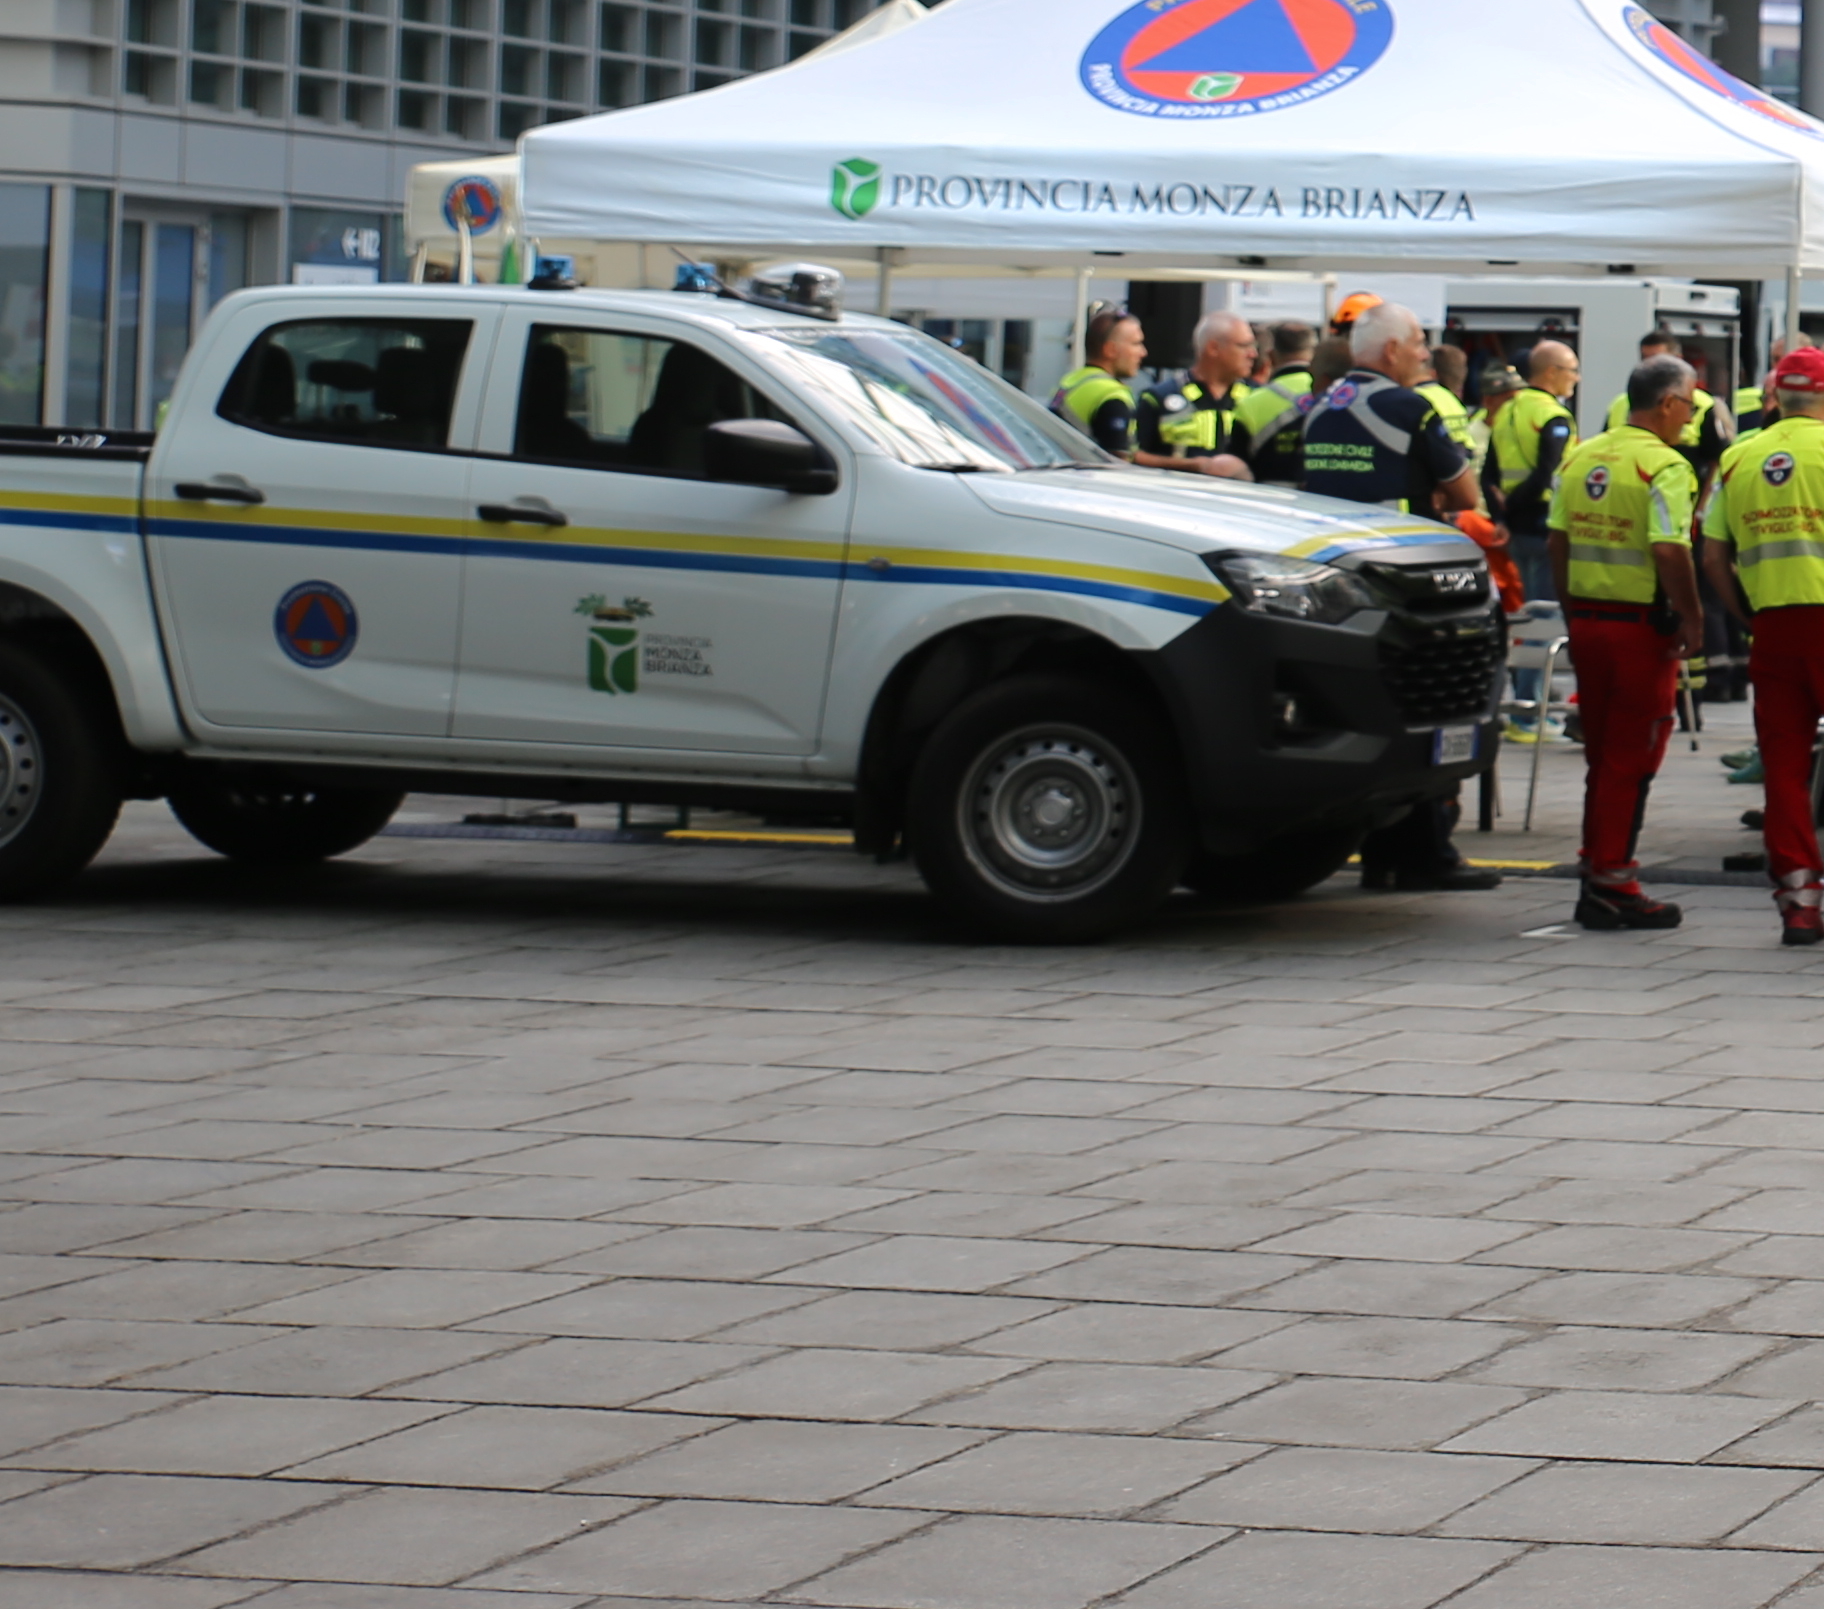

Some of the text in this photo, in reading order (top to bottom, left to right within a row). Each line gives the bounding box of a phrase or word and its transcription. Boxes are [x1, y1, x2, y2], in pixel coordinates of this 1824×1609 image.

[1089, 62, 1360, 117] PROVINCIA MONZA BRIANZA
[891, 175, 1477, 222] PROVINCIA MONZA BRIANZA
[645, 646, 704, 662] MONZA
[645, 659, 715, 677] BRIANZA
